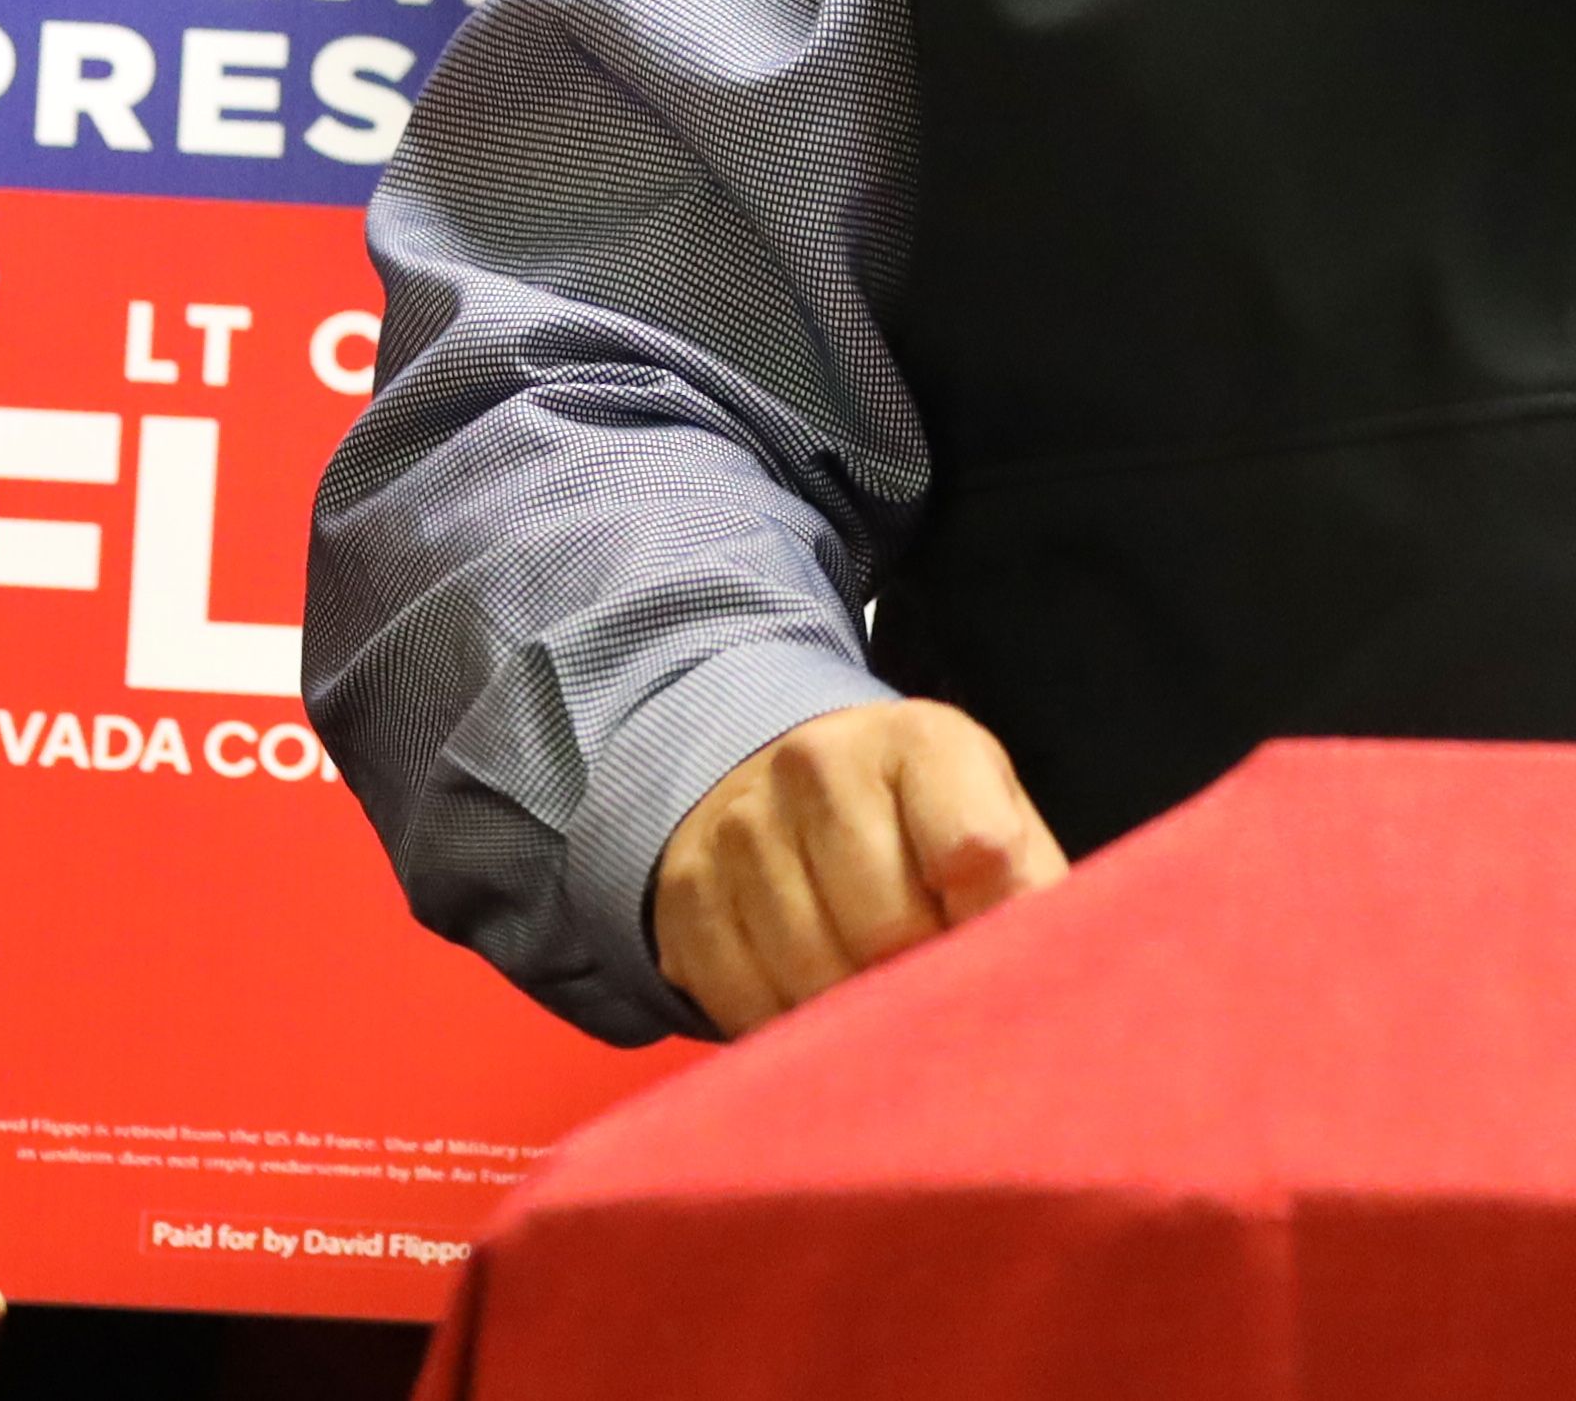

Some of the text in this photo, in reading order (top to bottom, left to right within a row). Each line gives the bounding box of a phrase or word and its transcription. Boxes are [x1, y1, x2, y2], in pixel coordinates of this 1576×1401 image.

[124, 300, 252, 387] LT
[152, 1220, 474, 1266] Paid for by David Flippo
